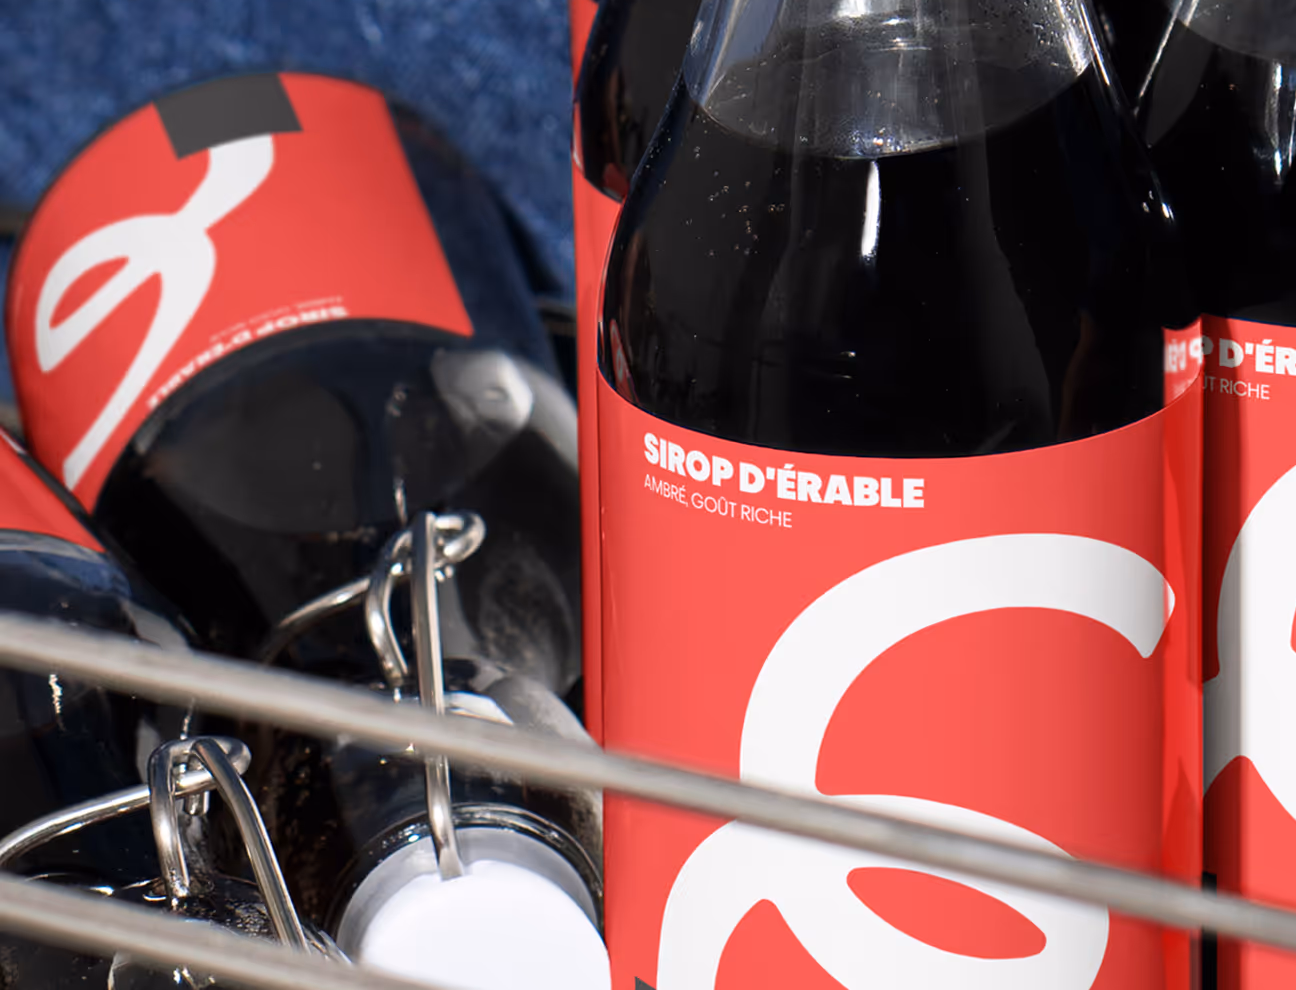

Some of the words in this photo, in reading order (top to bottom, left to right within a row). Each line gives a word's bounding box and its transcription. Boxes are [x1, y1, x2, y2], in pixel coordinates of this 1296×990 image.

[1220, 376, 1270, 399] RICHE
[644, 432, 734, 486] SIROP
[739, 462, 925, 508] D'ÉRABLE
[644, 474, 688, 507] AMBRÉ,
[691, 493, 736, 518] GOÛT
[740, 506, 792, 528] RICHE
